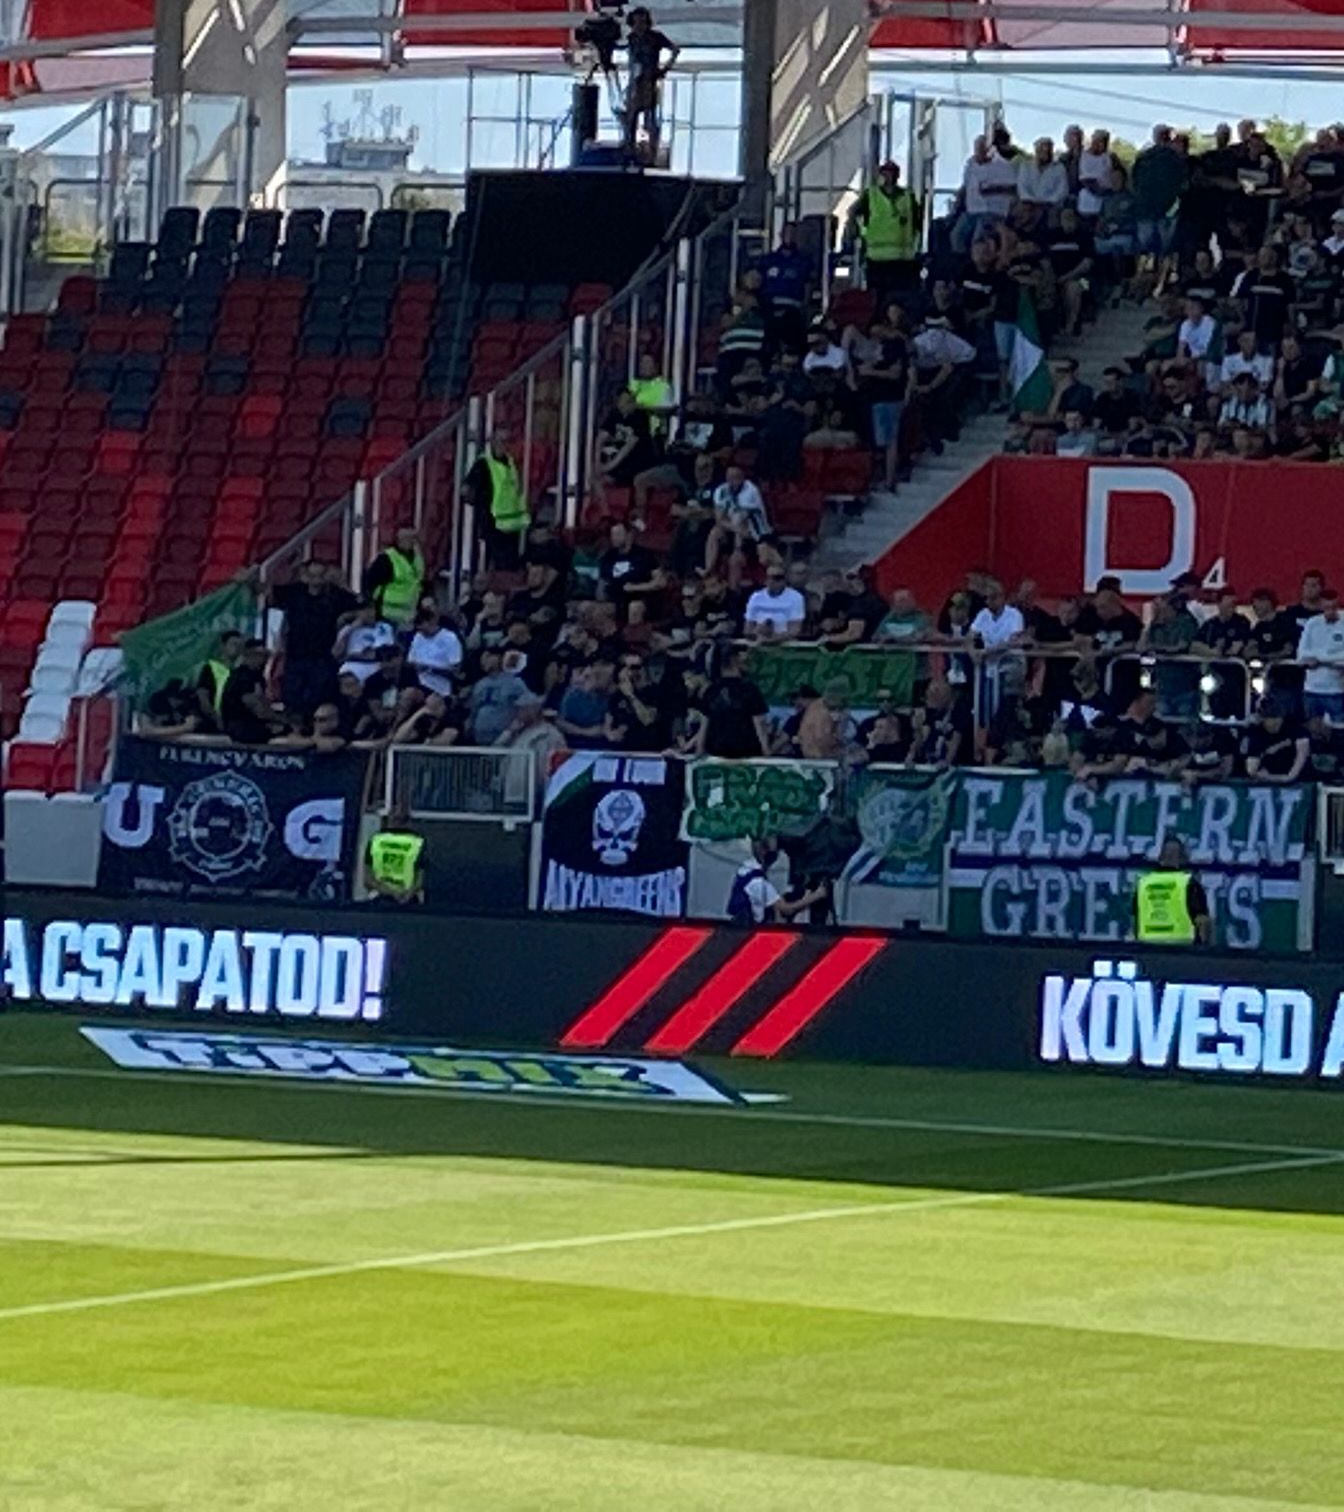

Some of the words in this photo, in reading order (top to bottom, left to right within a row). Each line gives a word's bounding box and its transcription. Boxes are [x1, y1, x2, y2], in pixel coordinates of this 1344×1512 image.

[1084, 466, 1196, 594] D
[957, 779, 1305, 866] EASTERN
[981, 864, 1263, 950] GRES
[40, 920, 387, 1021] CSAPATOD!
[1041, 960, 1313, 1073] KÖVESD
